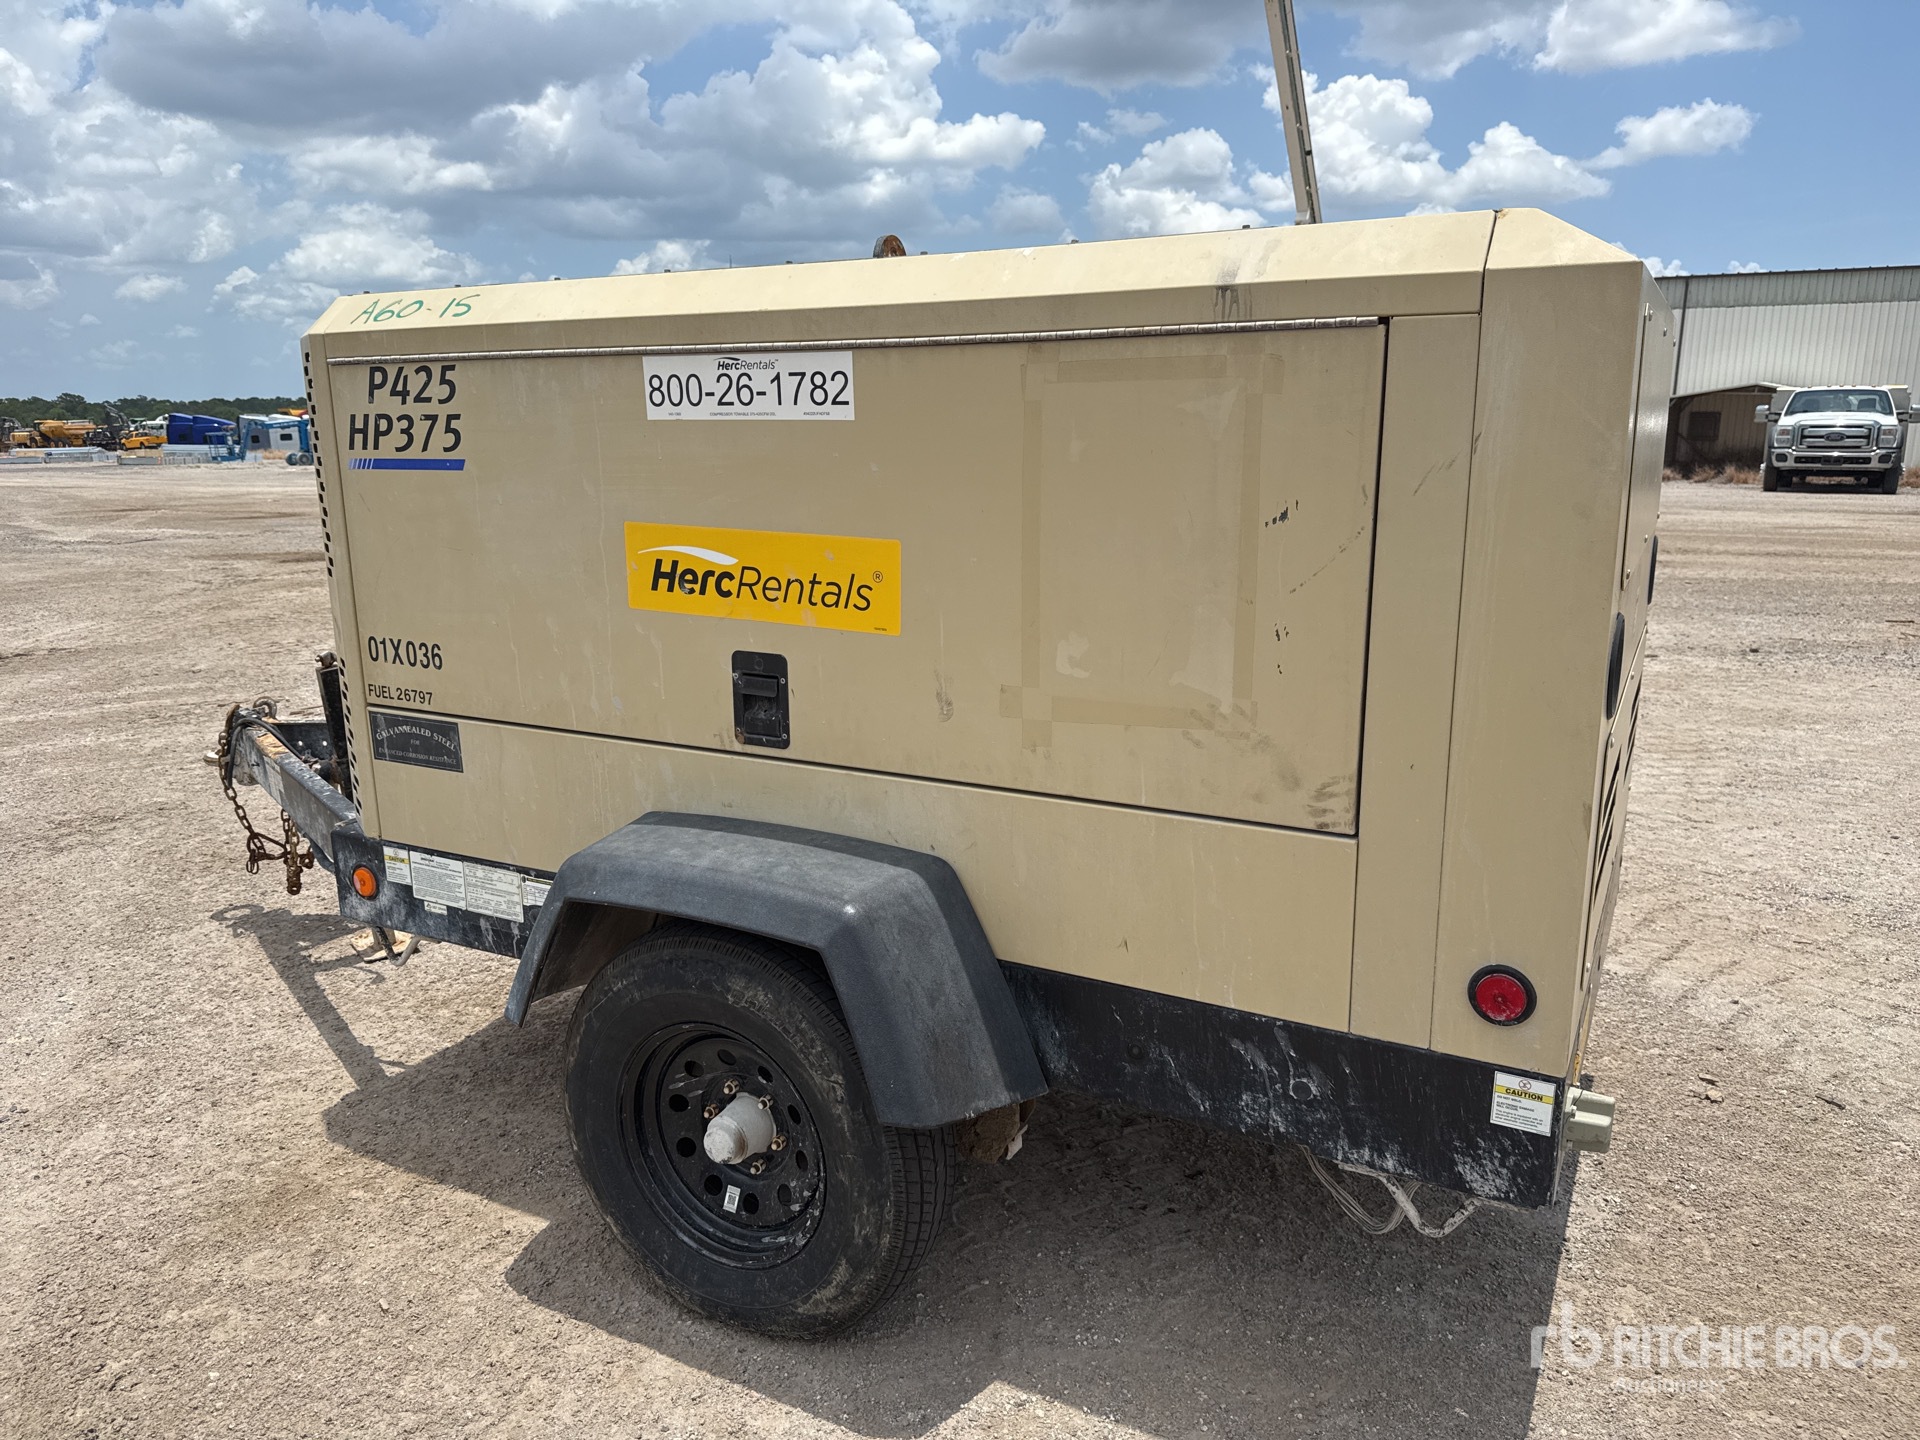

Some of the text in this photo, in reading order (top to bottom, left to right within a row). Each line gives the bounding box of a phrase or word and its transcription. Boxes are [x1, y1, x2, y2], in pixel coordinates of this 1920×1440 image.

[368, 364, 457, 405] P425
[648, 370, 850, 408] 800-26-1782
[348, 412, 462, 453] HP375
[368, 635, 443, 671] 01X036
[368, 683, 433, 706] FUEL 26797
[433, 732, 456, 752] STEEL
[1505, 1088, 1544, 1102] CAUTION
